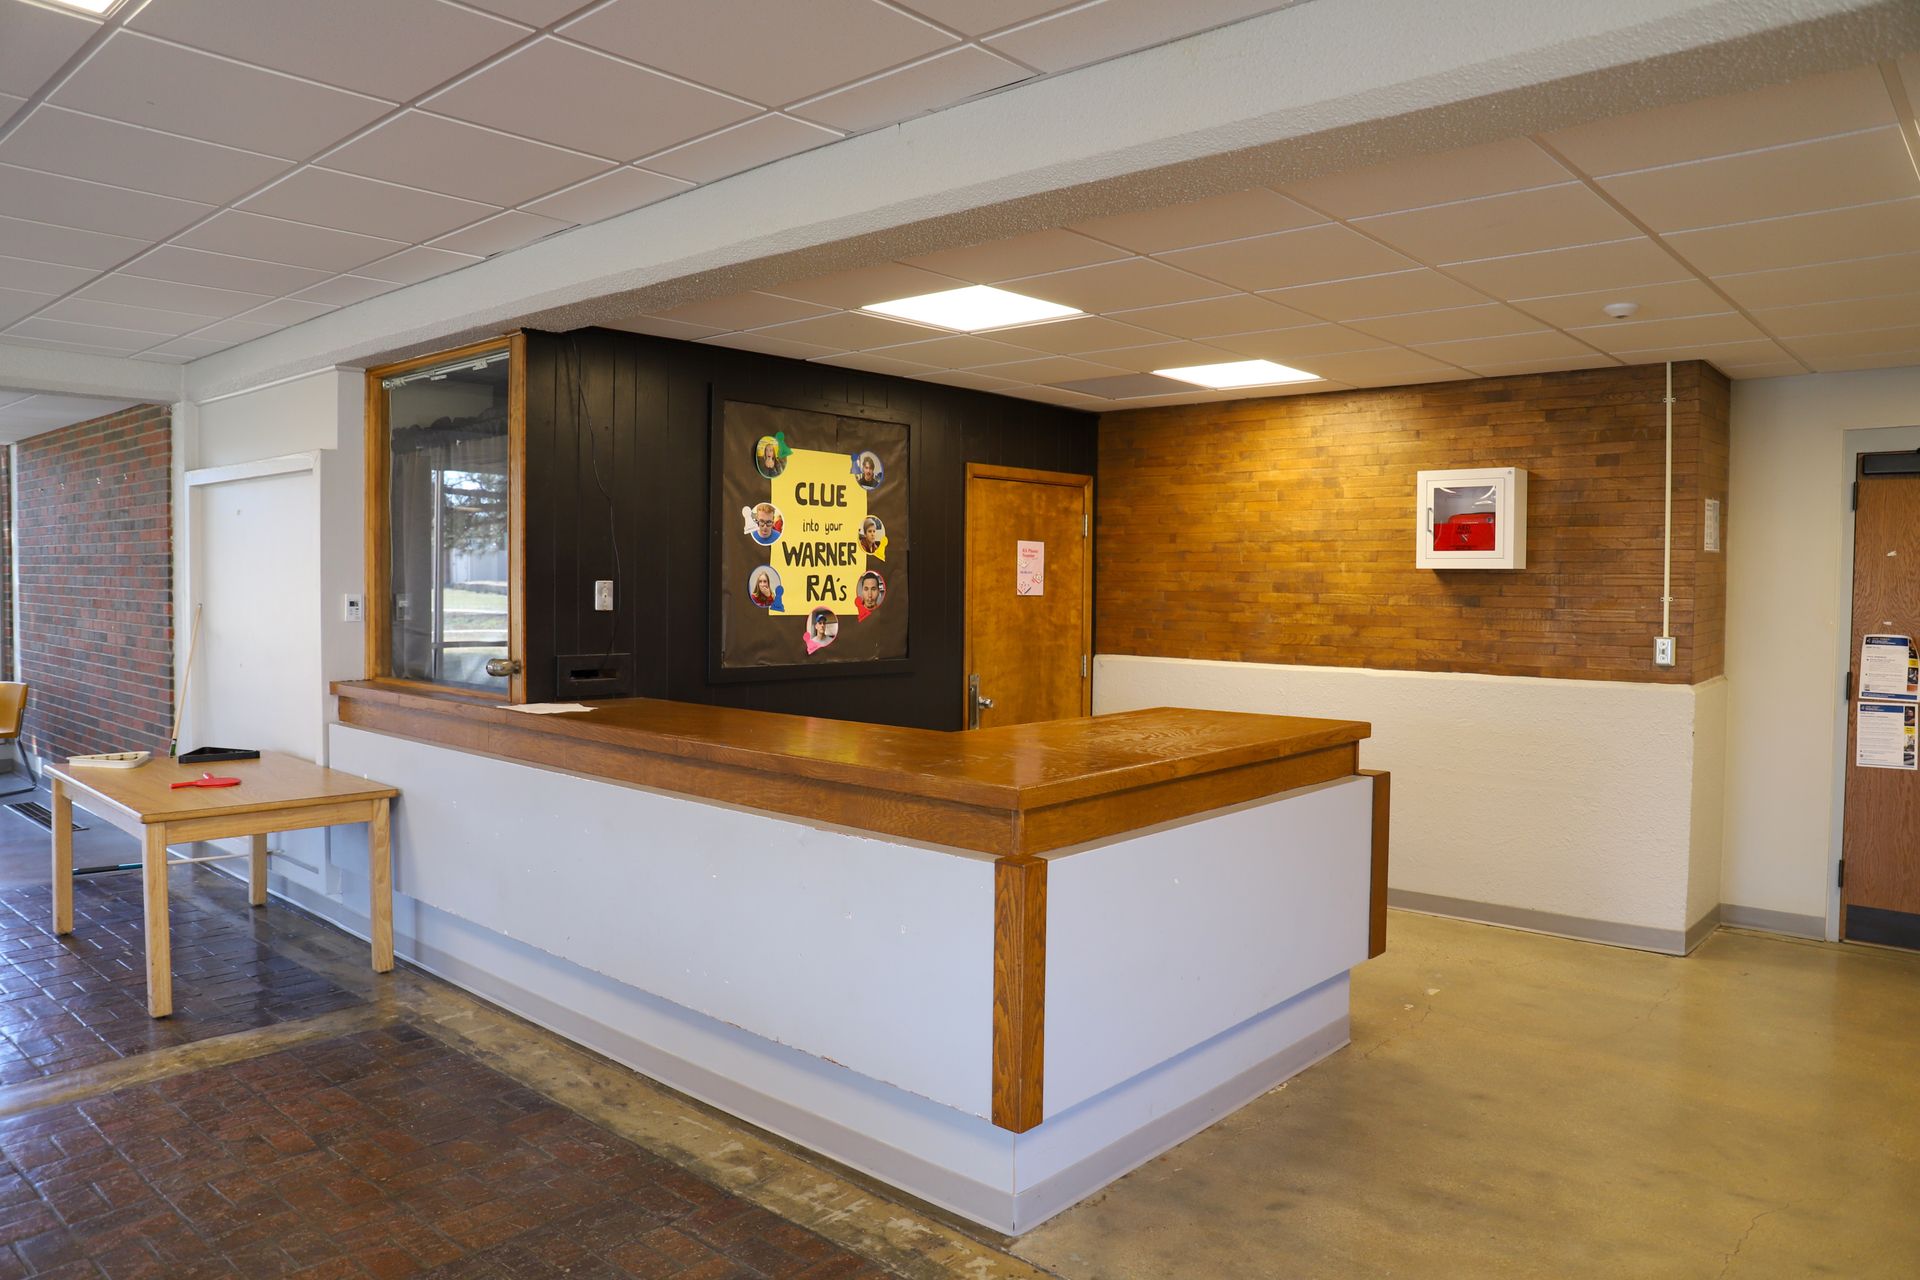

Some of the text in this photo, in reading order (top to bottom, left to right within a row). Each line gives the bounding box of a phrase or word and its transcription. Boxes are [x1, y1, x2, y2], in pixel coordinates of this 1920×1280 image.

[795, 482, 847, 507] CLUE
[803, 519, 843, 535] into your
[782, 541, 857, 567] WARNER
[806, 574, 848, 602] RA's
